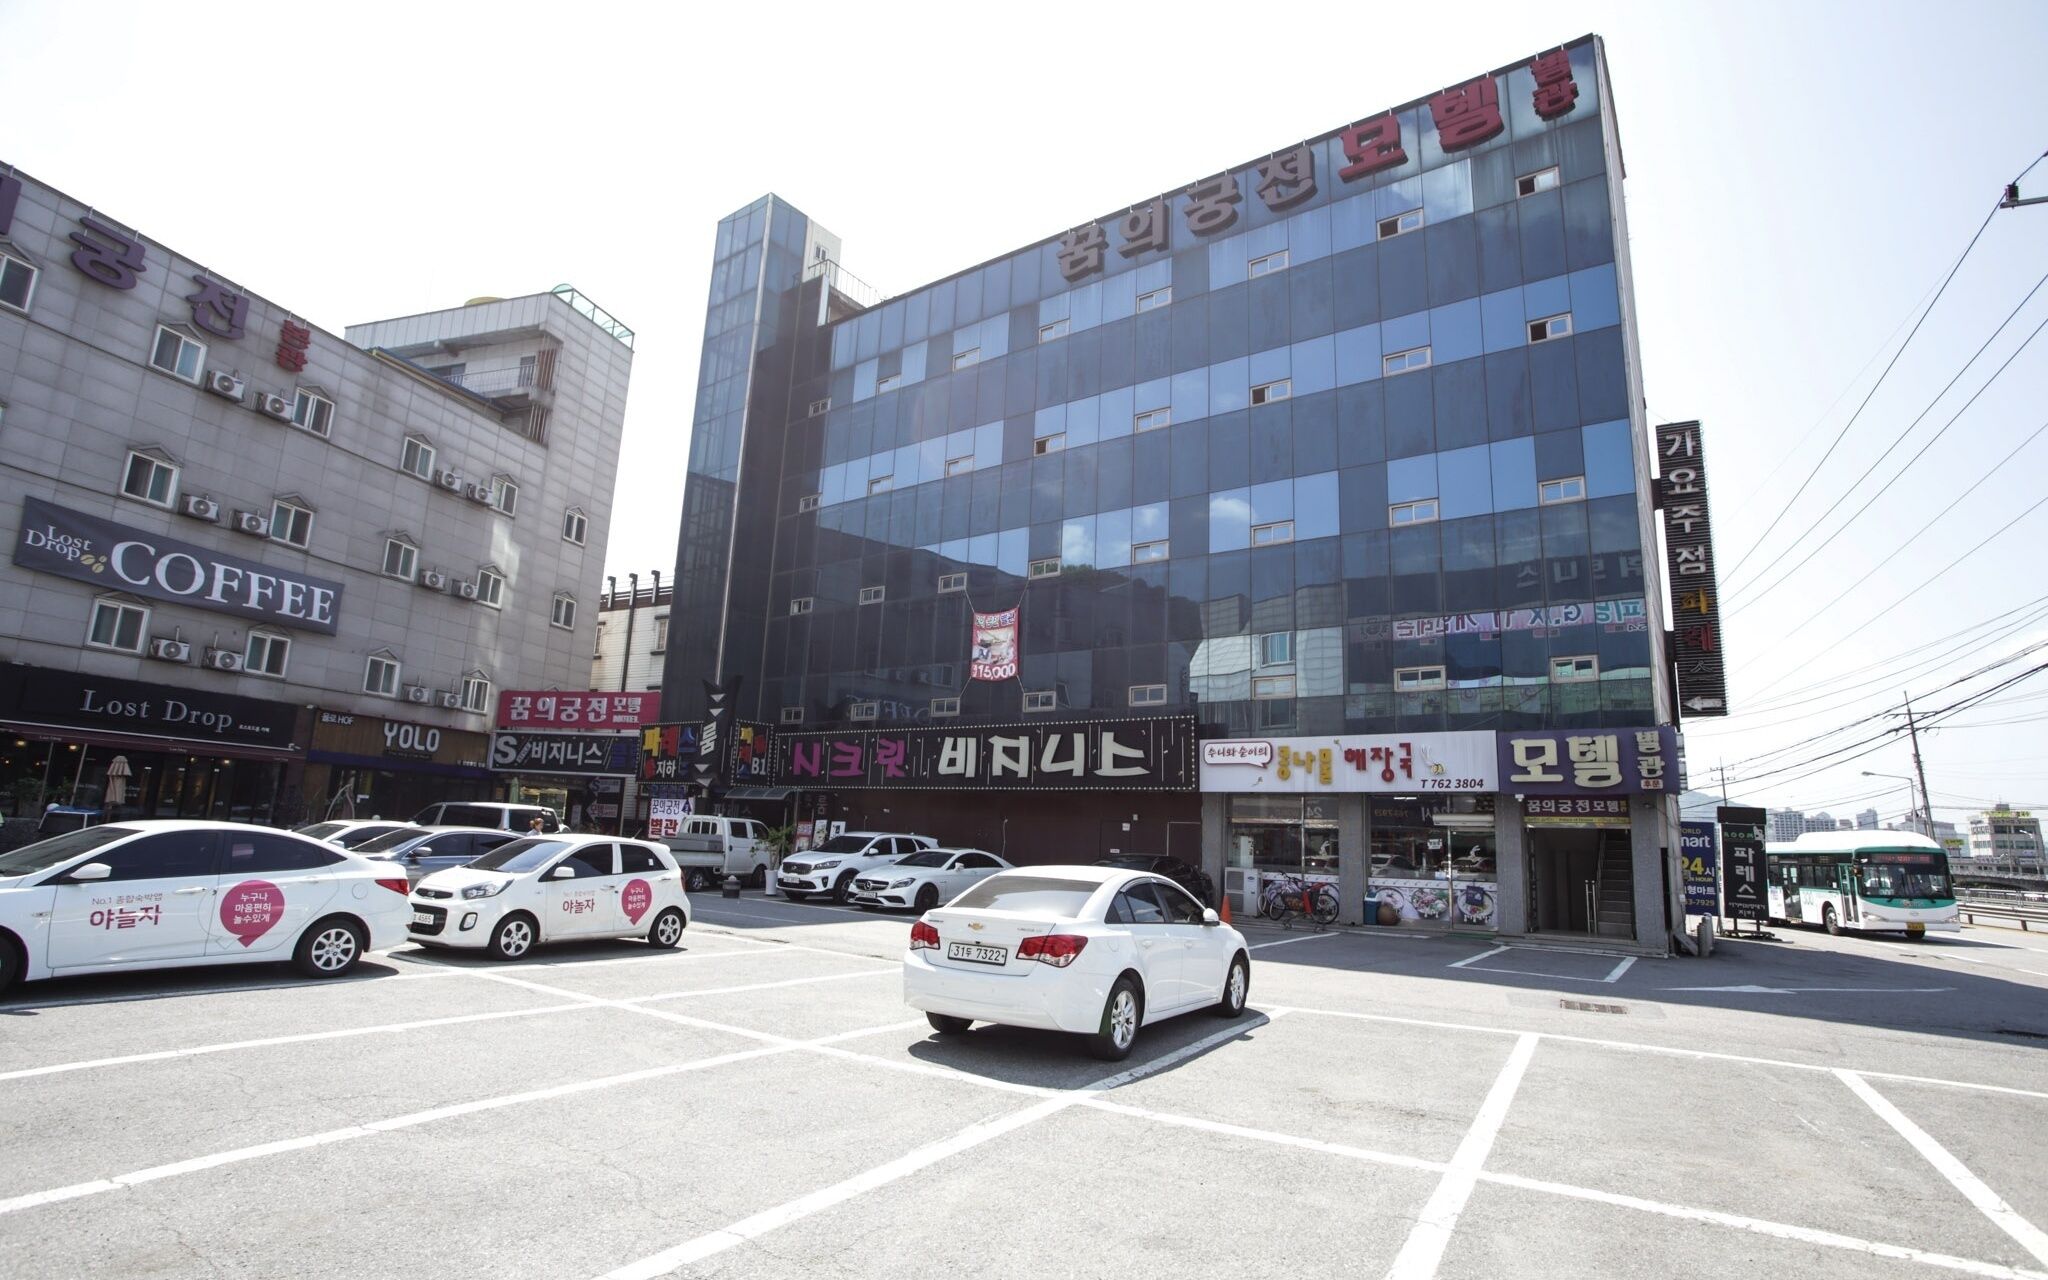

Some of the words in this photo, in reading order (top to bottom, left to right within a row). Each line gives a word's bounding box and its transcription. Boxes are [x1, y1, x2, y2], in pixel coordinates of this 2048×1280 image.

[1056, 144, 1319, 283] 꿈의궁전
[1337, 74, 1505, 183] 모텔
[1664, 430, 1707, 575] 가요주점
[25, 528, 82, 561] Drop
[46, 525, 92, 551] Lost
[111, 540, 336, 625] COFFEE
[80, 689, 151, 719] Lost
[162, 700, 234, 734] Drop
[338, 713, 354, 725] HOF
[509, 696, 608, 723] 꿈의궁전
[383, 722, 441, 753] YOLO
[493, 735, 518, 765] S
[531, 740, 603, 767] 비지니스
[751, 757, 767, 776] B1
[792, 736, 906, 779] 시크릿
[938, 730, 1151, 779] 비지니스
[1276, 744, 1334, 786] 콩나물
[1343, 742, 1413, 783] 해장국
[1510, 734, 1623, 788] 모텔
[656, 760, 676, 779] 지하
[1420, 779, 1429, 789] T
[1430, 778, 1452, 789] 762
[1454, 778, 1484, 789] 3804
[652, 799, 681, 815] 꿈의궁전
[1527, 799, 1590, 813] 꿈의궁전
[1592, 800, 1620, 813] 모텔
[650, 817, 679, 838] 별관
[1733, 846, 1757, 900] 파레스
[92, 896, 112, 906] No.1
[116, 892, 164, 905] 종합숙박앱
[234, 902, 272, 913] 마음편히
[240, 892, 268, 902] 누구나
[562, 898, 595, 914] 야놀자
[89, 904, 163, 930] 야놀자
[233, 913, 271, 925] 놀수있게
[953, 945, 973, 957] 31두
[976, 948, 1001, 962] 7322
